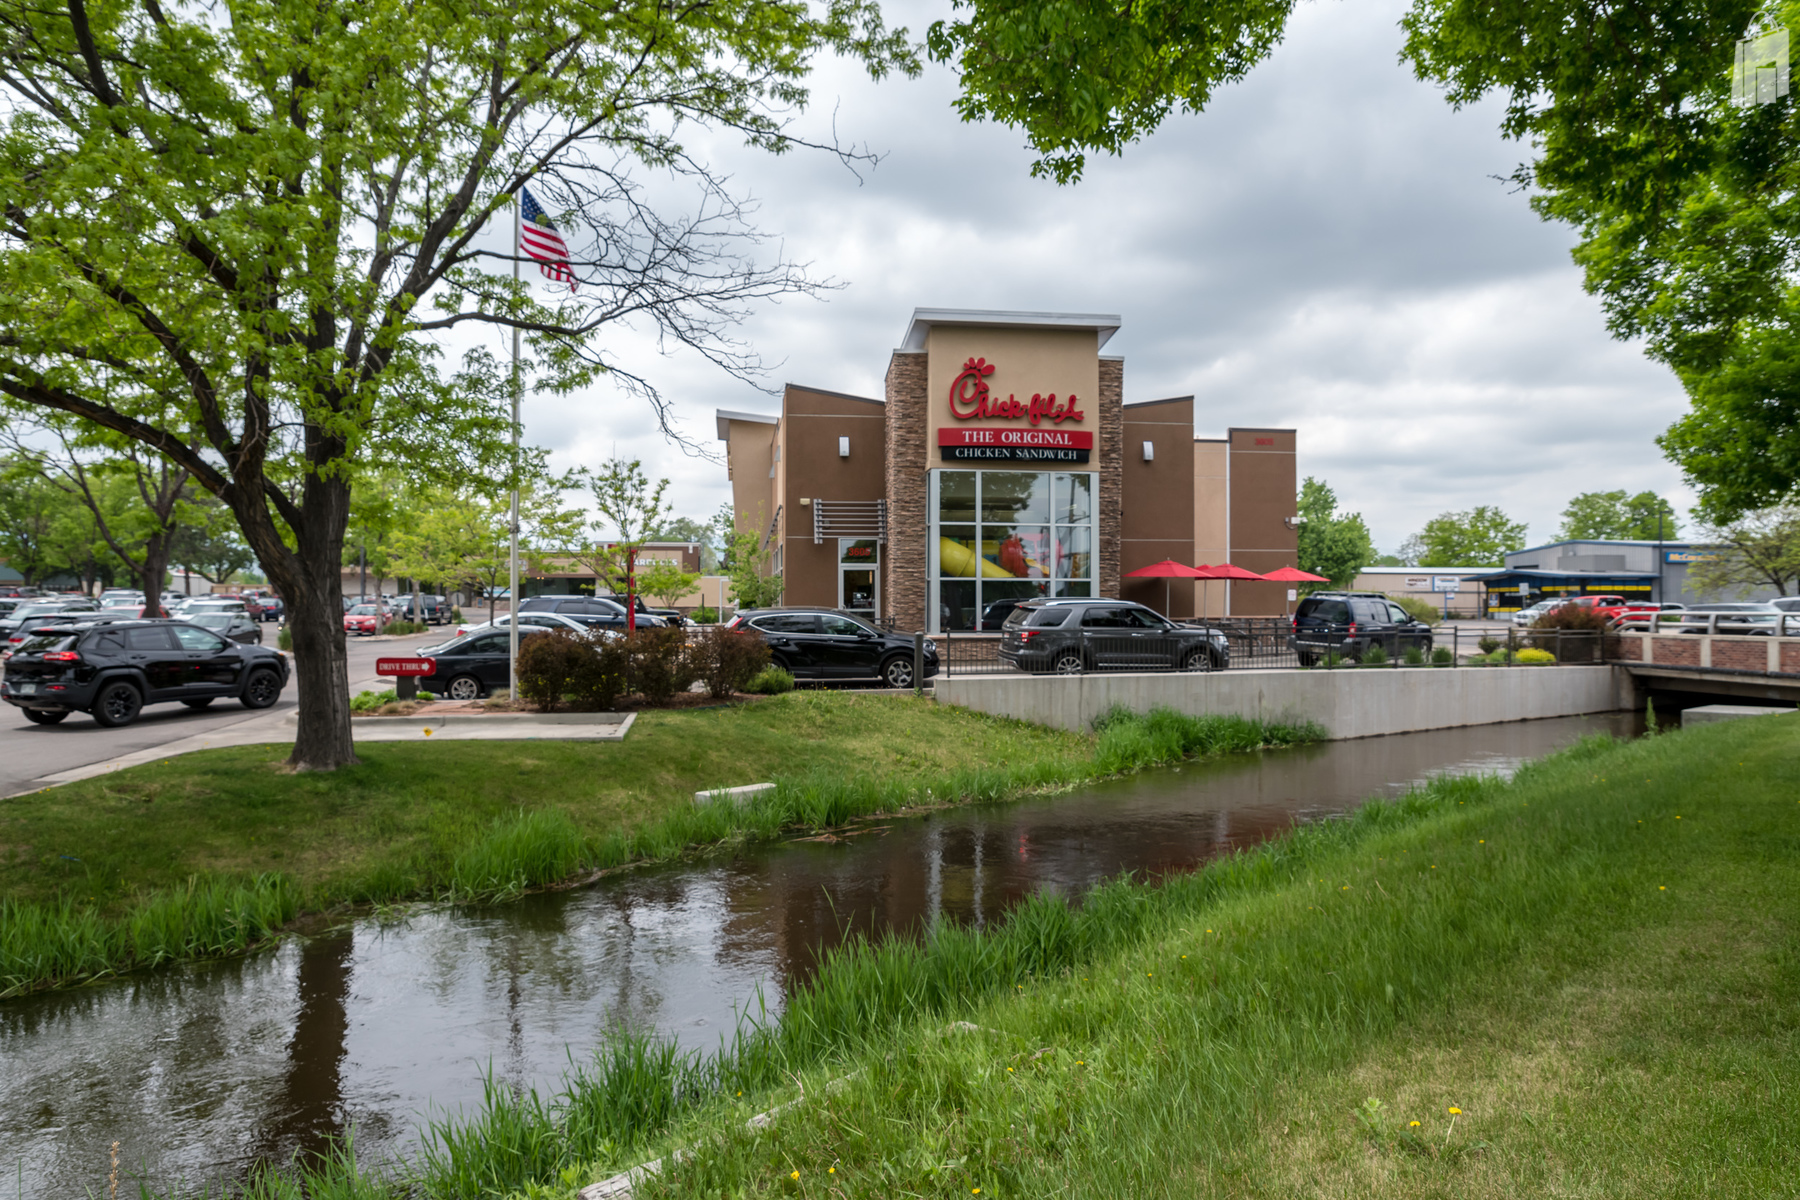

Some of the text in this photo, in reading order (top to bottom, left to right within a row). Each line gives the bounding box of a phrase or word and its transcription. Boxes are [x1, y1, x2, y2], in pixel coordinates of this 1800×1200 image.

[949, 361, 1085, 426] Chick-fil-A
[962, 431, 1072, 445] THE ORIGINAL
[955, 448, 1077, 460] CHICKEN SANDWICH
[848, 547, 870, 557] 3605
[378, 662, 421, 671] DRIVE THRU
